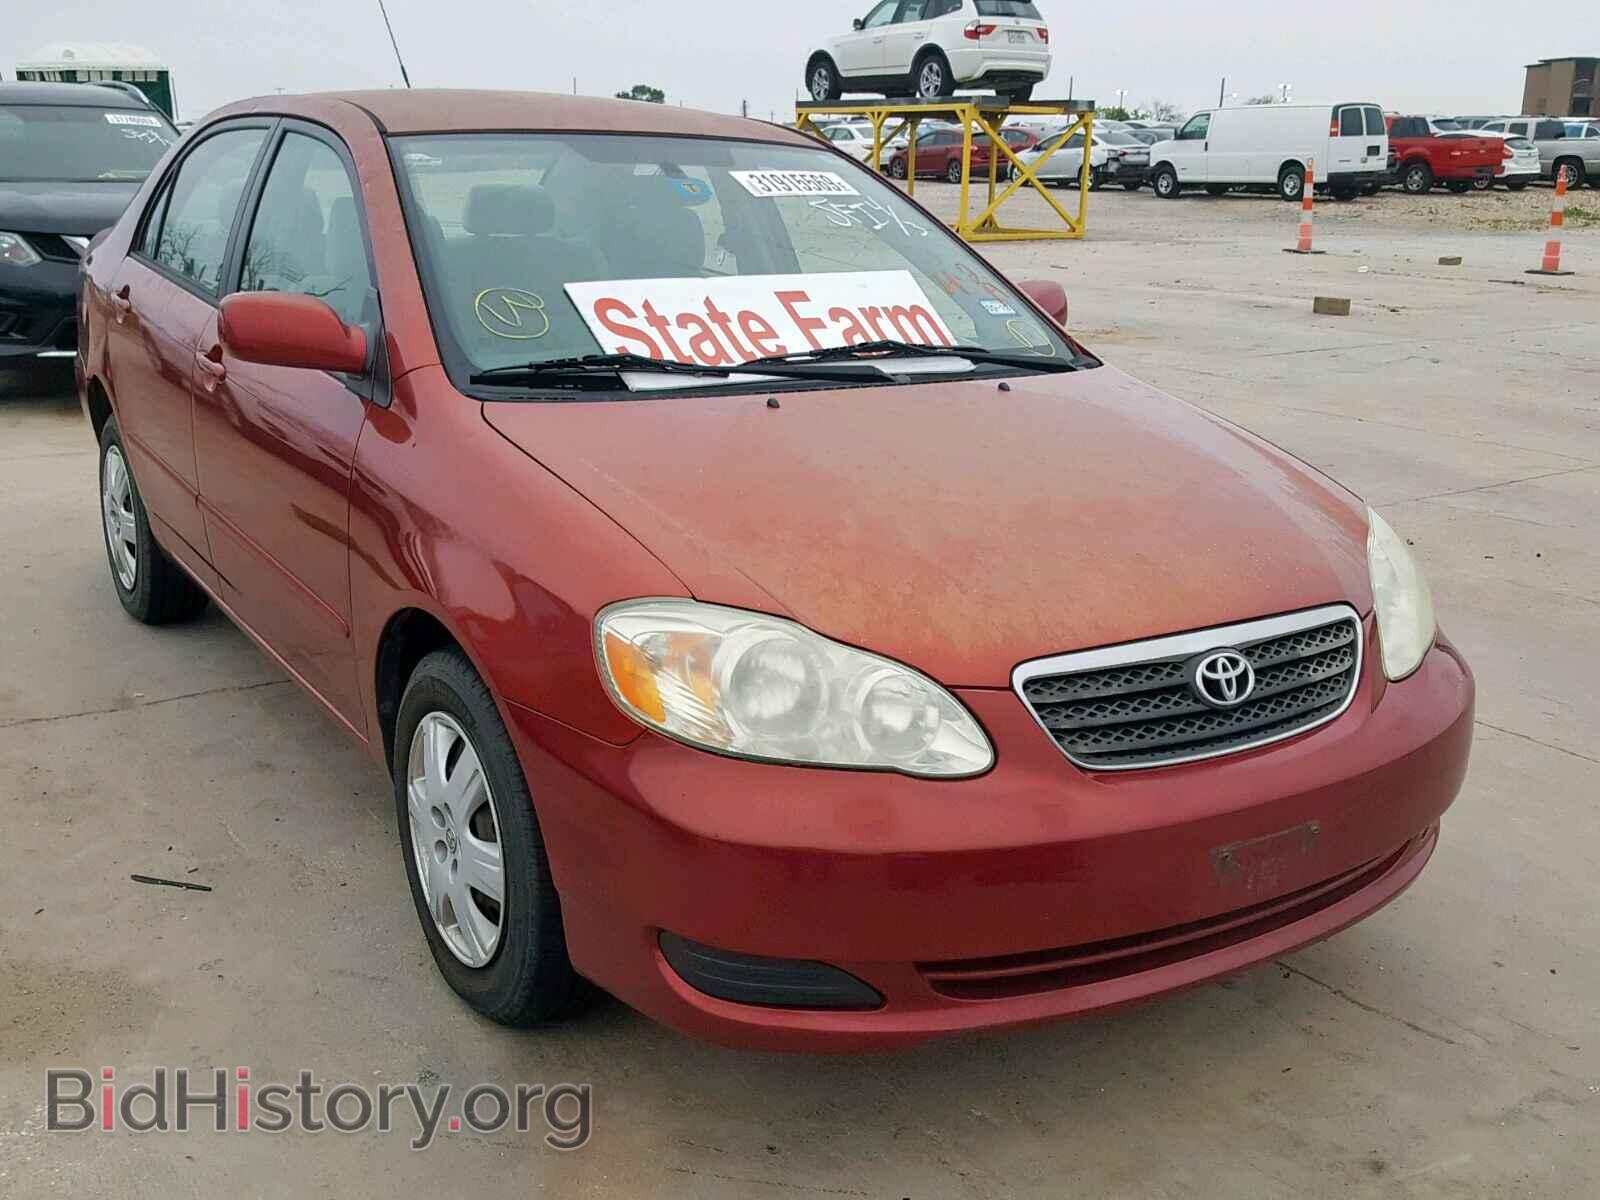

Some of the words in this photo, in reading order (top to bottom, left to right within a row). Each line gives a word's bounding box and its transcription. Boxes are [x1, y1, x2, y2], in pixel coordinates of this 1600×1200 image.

[748, 173, 841, 193] 31915569
[593, 295, 788, 367] State
[774, 290, 953, 351] Farm
